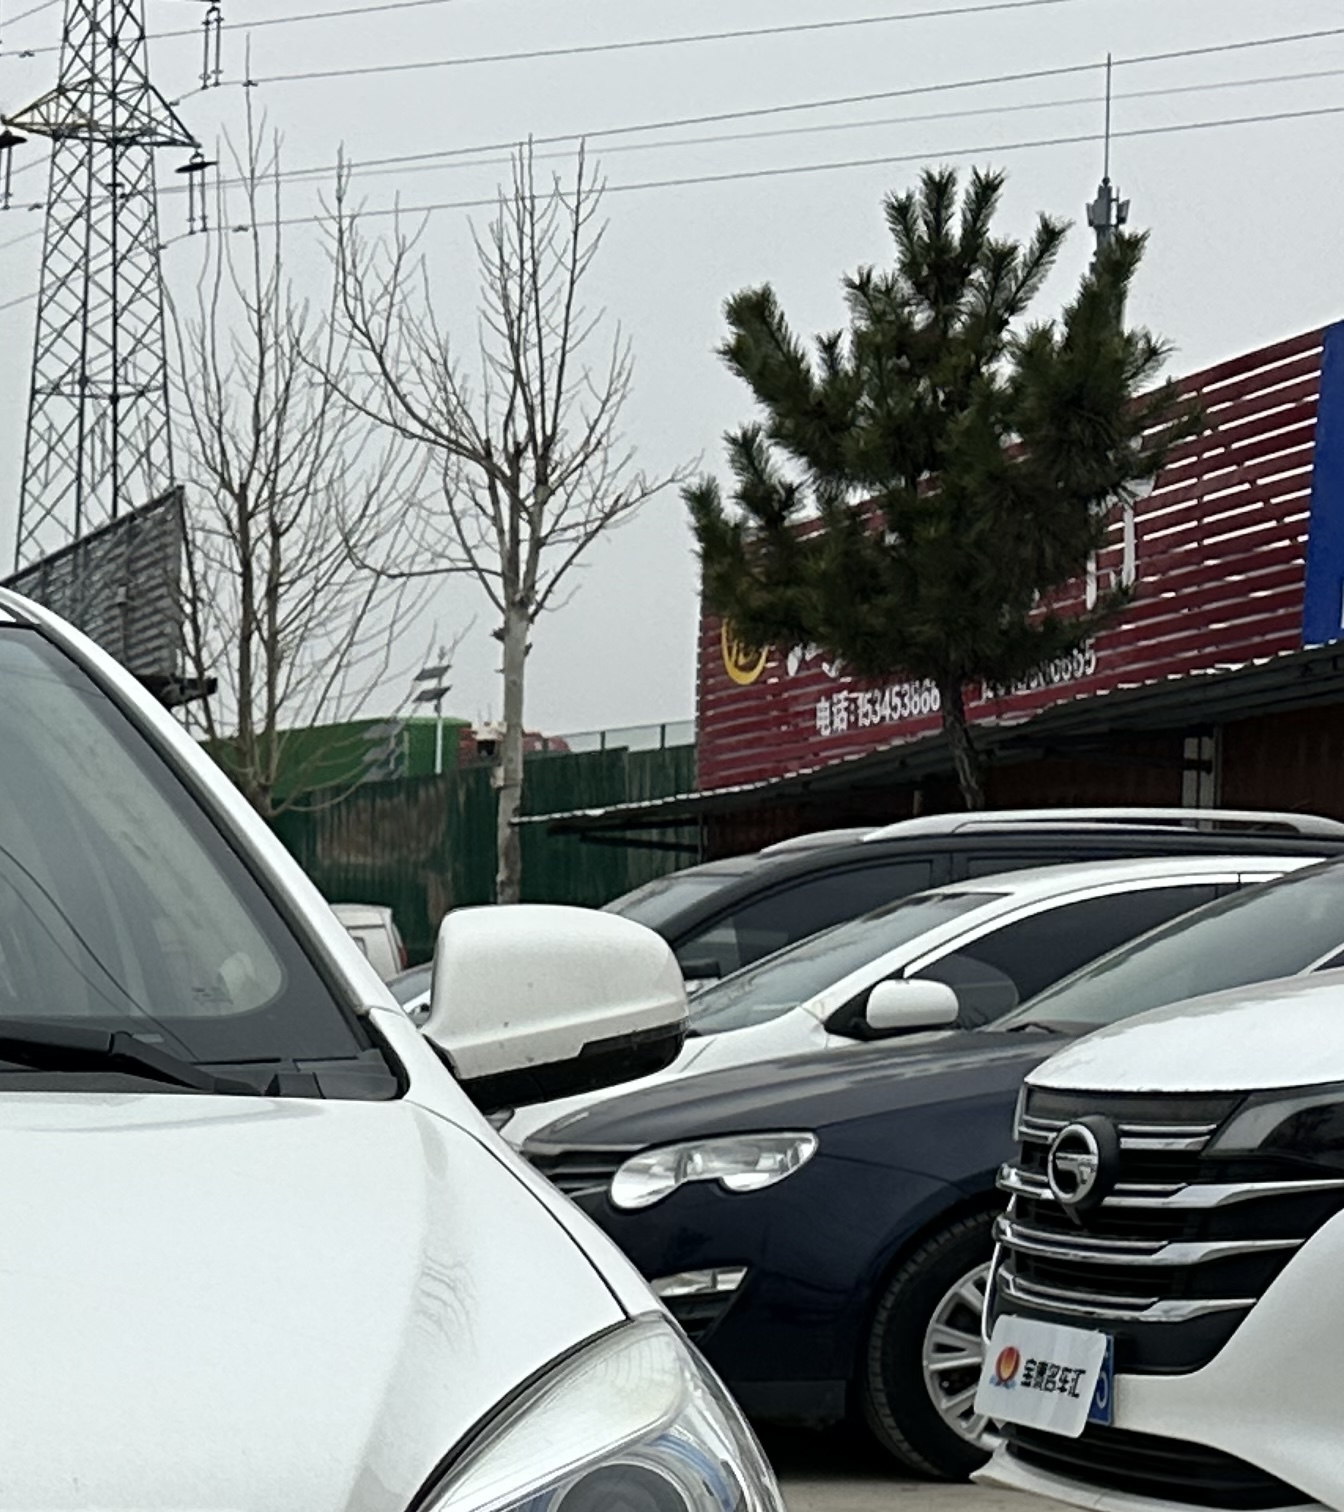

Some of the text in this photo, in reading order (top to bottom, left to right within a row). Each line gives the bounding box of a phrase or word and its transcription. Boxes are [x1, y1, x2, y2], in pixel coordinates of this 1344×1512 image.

[1020, 1358, 1086, 1399] 宝泰名车汇
